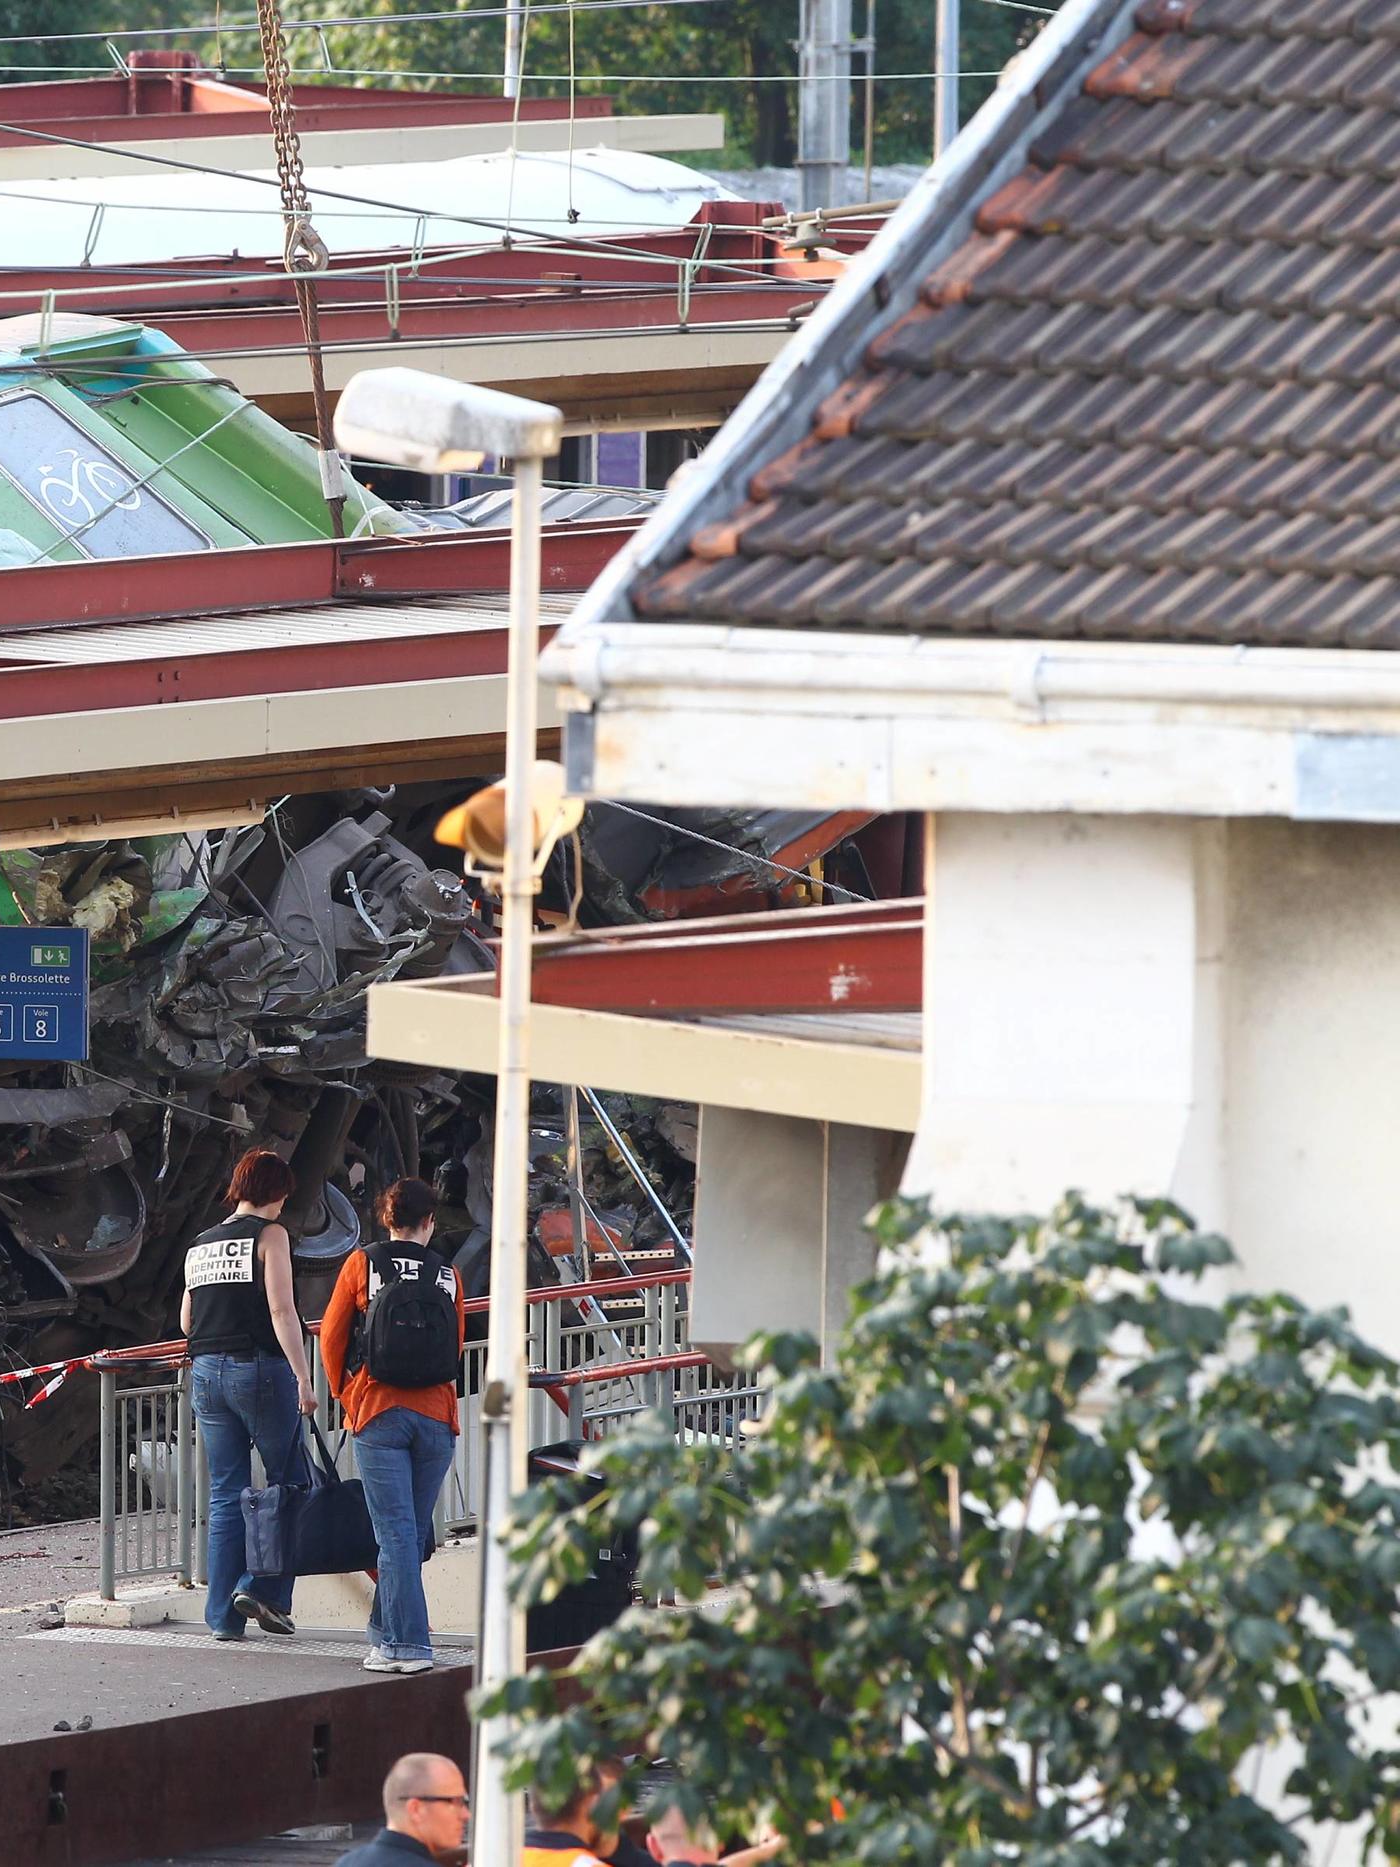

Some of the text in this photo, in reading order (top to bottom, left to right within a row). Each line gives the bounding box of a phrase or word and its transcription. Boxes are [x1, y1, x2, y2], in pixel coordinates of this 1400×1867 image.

[10, 972, 70, 984] Brossolette
[33, 1009, 49, 1017] Voie
[35, 1020, 47, 1038] 8
[188, 1240, 251, 1263] POLICE
[191, 1259, 243, 1275] IDENTITE
[187, 1271, 249, 1287] JUDICIAIRE
